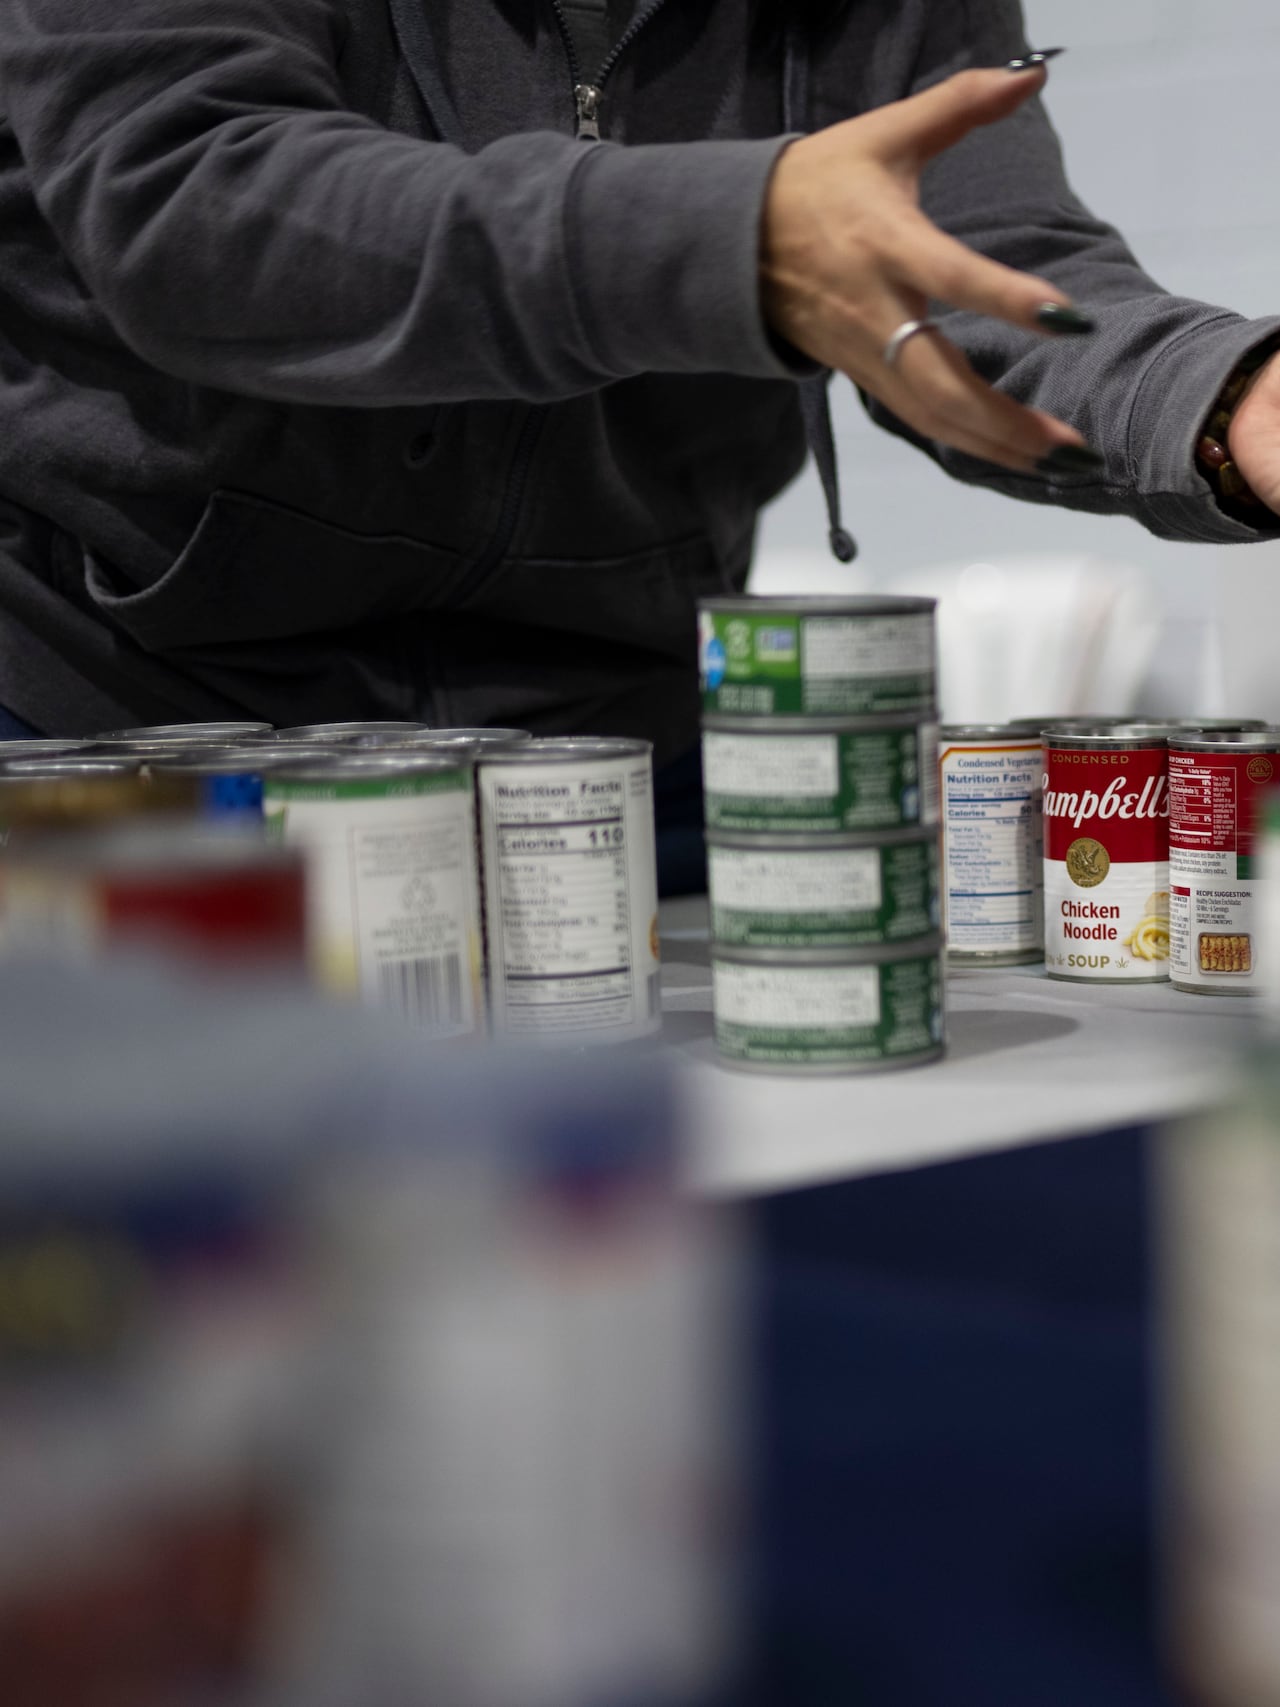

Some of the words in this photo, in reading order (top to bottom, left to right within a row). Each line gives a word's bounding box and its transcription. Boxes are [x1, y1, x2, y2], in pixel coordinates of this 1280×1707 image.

[958, 758, 1005, 768] Condensed
[1053, 754, 1130, 764] CONDENSED
[947, 774, 1000, 784] Nutrition
[1003, 773, 1032, 783] Facts
[498, 786, 569, 798] Nutrition
[580, 781, 622, 794] Facts
[503, 839, 567, 850] Calories
[588, 827, 624, 845] 110
[1214, 890, 1253, 898] SUGGESTION:
[1061, 900, 1120, 919] Chicken
[1063, 922, 1118, 940] Noodle
[1067, 954, 1110, 968] SOUP
